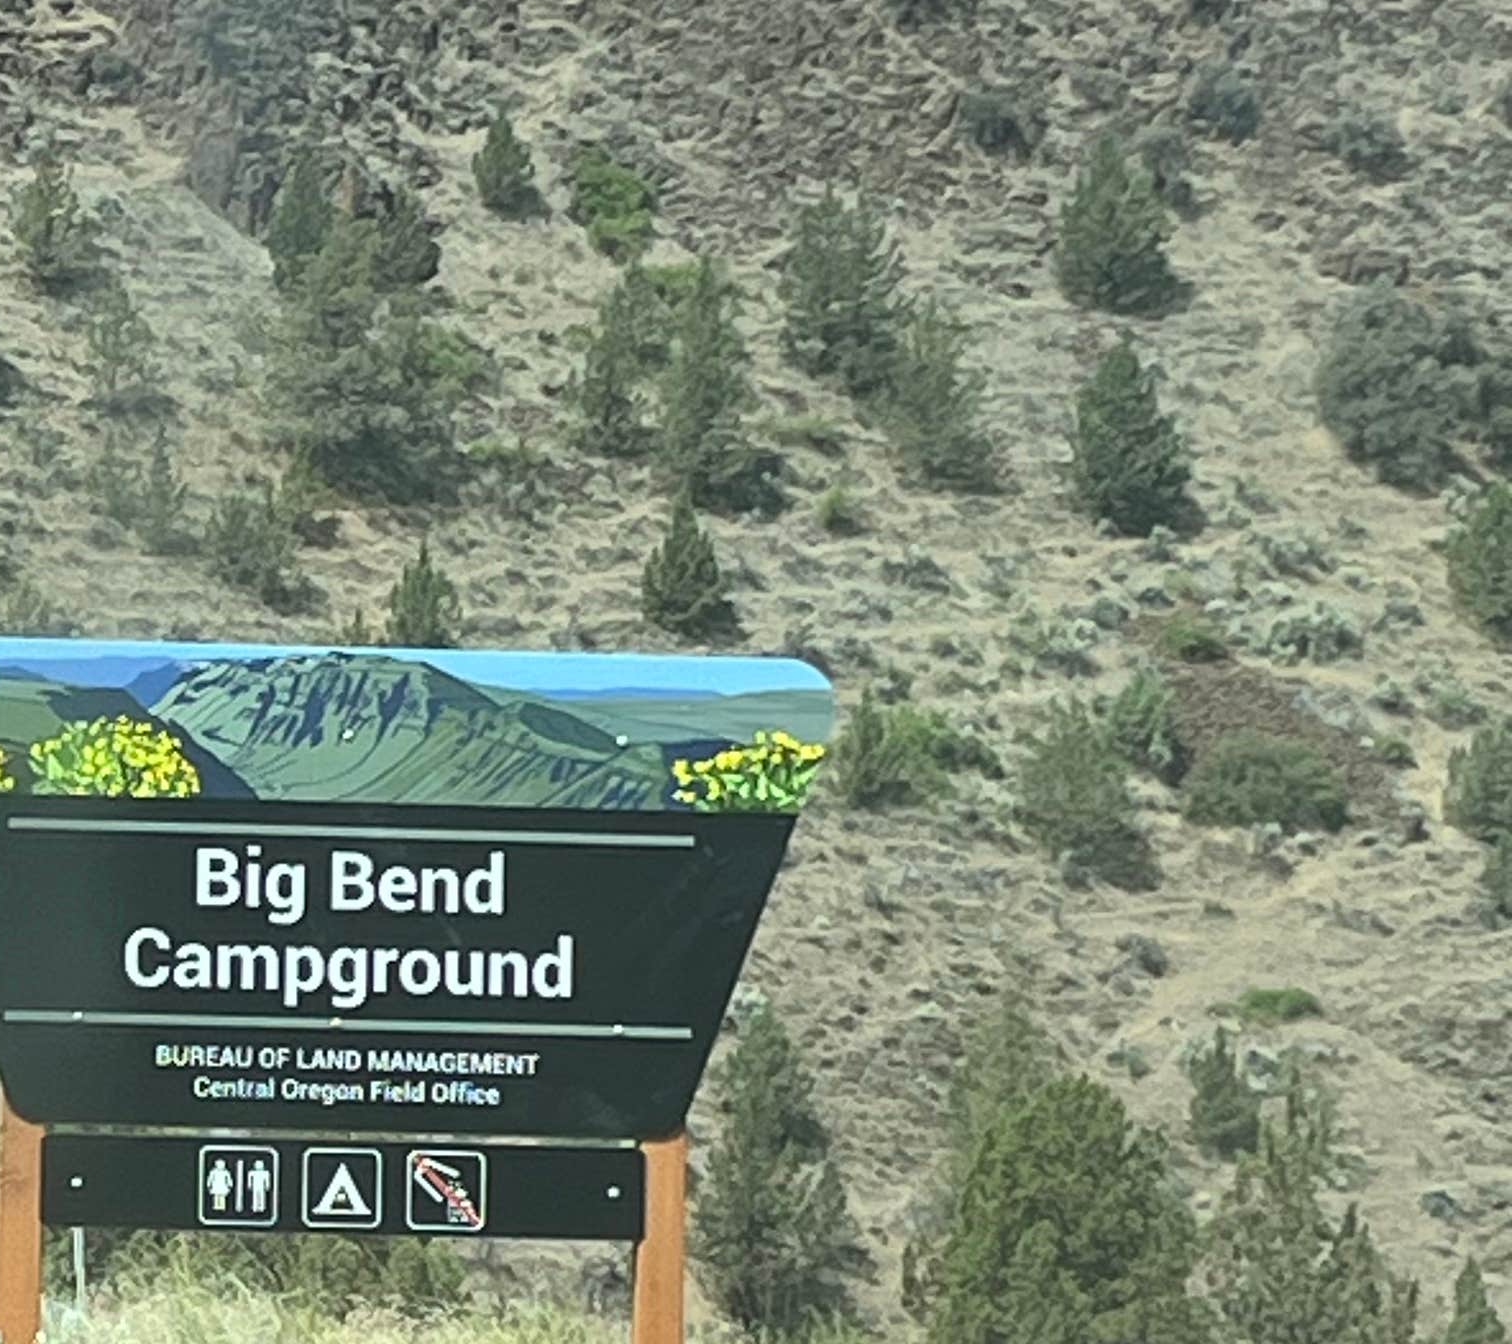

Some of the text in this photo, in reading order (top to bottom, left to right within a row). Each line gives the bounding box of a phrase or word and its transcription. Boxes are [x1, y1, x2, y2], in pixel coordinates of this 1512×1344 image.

[196, 845, 505, 924] Big Bend
[124, 927, 573, 1008] Campground
[155, 1044, 540, 1075] BUREAU OF LAND MANAGEMENT
[193, 1075, 501, 1105] Central Oregon Field Office
